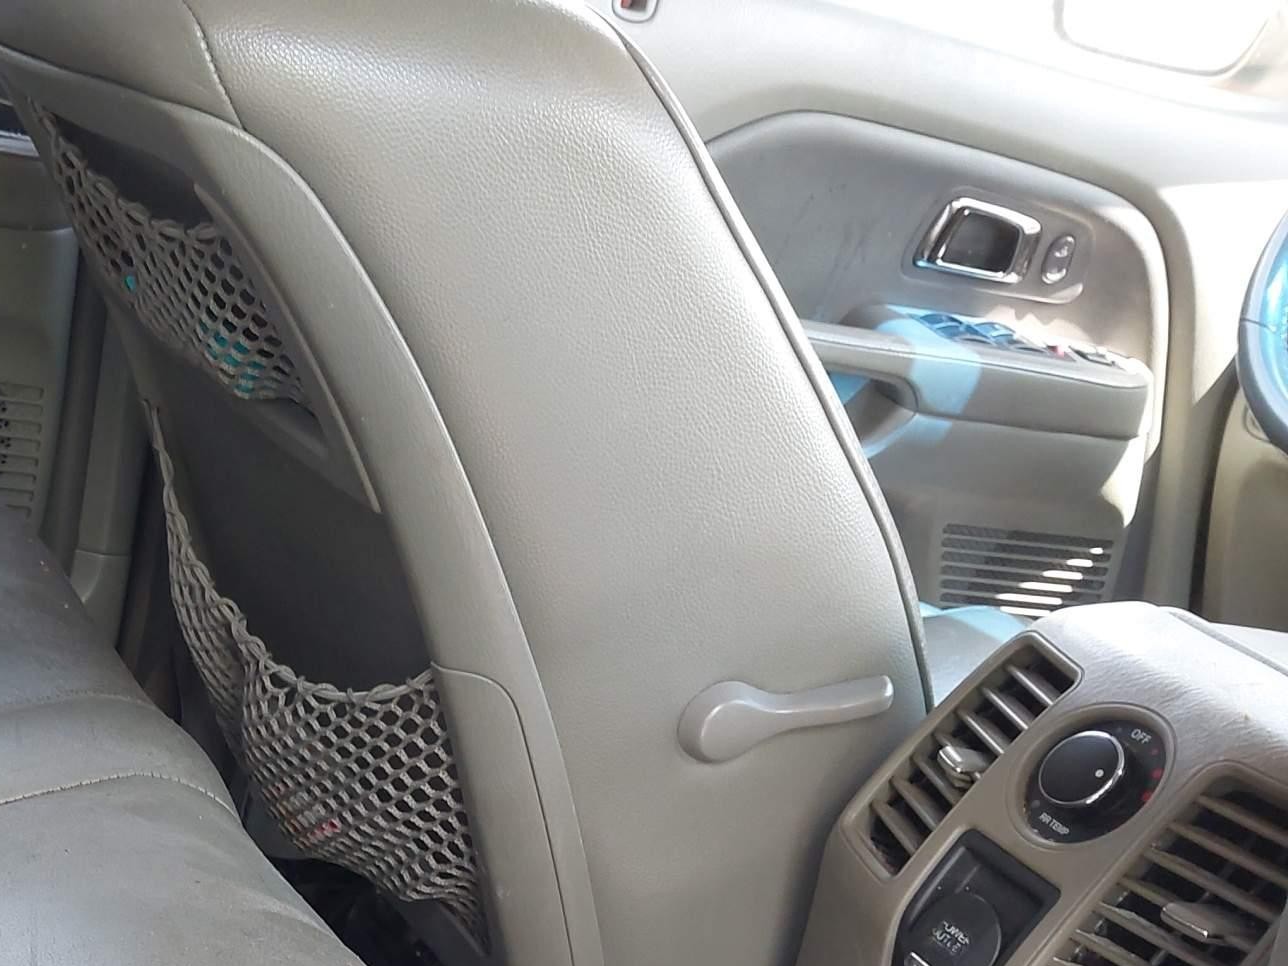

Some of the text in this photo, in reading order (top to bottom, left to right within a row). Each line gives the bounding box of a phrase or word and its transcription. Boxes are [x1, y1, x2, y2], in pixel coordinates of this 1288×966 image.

[1131, 728, 1152, 744] OFF
[1049, 818, 1070, 835] TEMP
[932, 927, 963, 953] OUTLE
